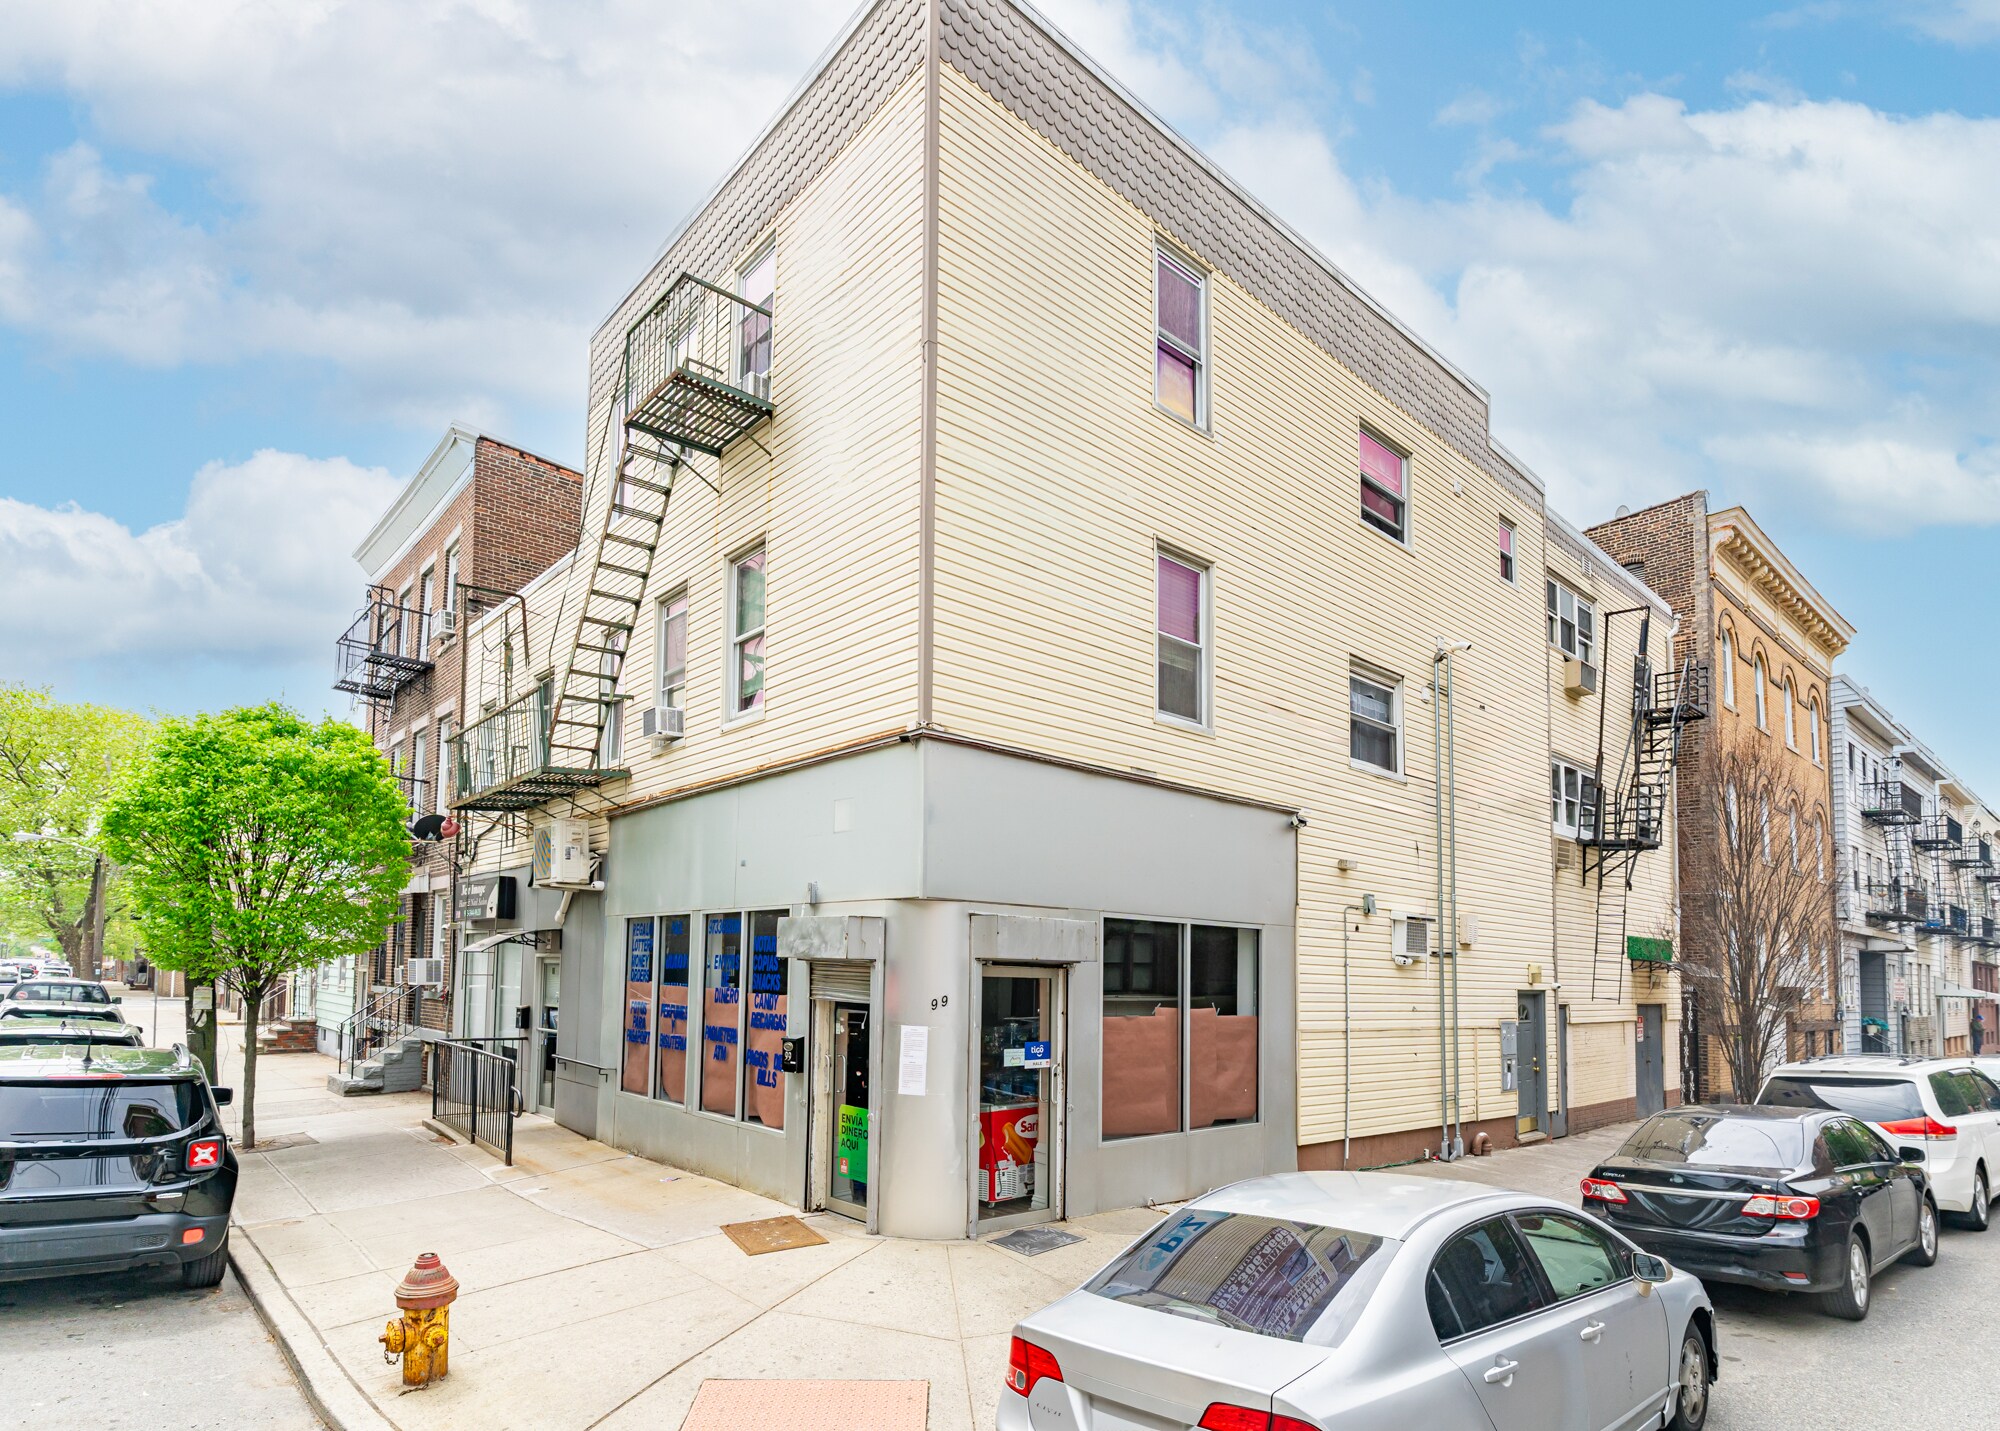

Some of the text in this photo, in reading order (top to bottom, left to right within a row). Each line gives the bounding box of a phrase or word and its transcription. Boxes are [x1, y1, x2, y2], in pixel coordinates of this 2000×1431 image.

[754, 935, 777, 952] NOTAR
[632, 954, 650, 967] MONEY
[753, 954, 778, 972] COPIAS
[630, 968, 650, 982] ORDERS
[752, 974, 781, 990] SNACKS
[714, 986, 739, 1004] DINERO
[754, 992, 778, 1010] CANDY
[633, 1015, 646, 1030] PARA
[750, 1012, 787, 1031] RECARGAS
[713, 1044, 726, 1061] ATM
[746, 1048, 768, 1069] PAGOS
[784, 1052, 792, 1062] 99
[757, 1068, 777, 1088] BILLS
[842, 1113, 863, 1128] ENVÍA
[842, 1125, 868, 1140] DINERO
[841, 1138, 860, 1151] AQUÍ
